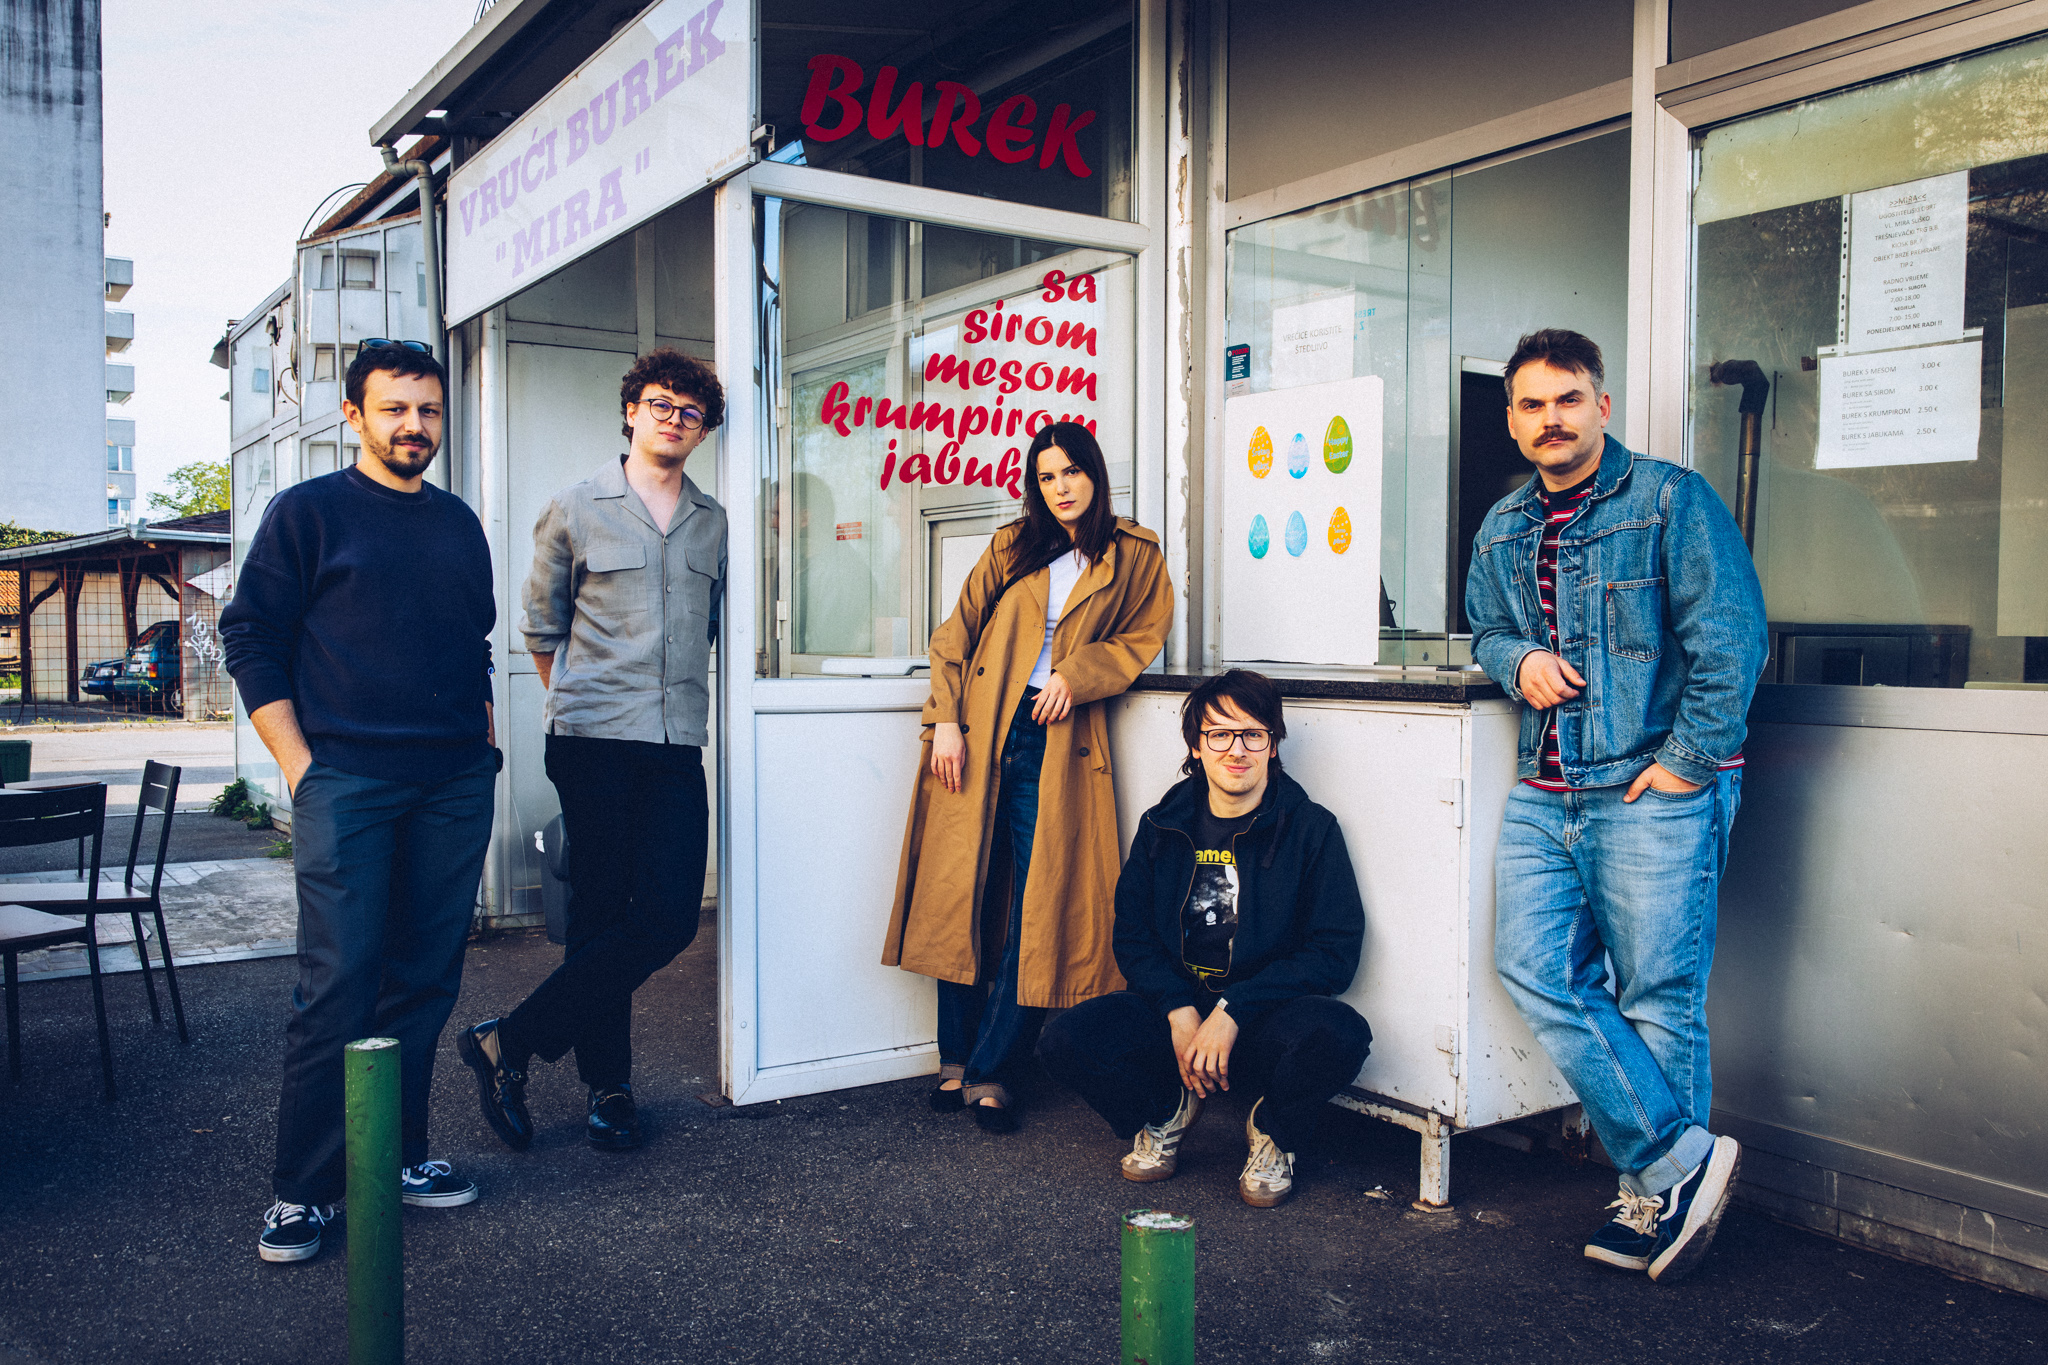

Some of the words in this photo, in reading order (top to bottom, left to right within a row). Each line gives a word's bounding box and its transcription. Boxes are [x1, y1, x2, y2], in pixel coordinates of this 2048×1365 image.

[459, 127, 558, 237] VRUĆI
[567, 0, 726, 167] BUREK
[800, 54, 1097, 178] BUREK
[1894, 219, 1910, 228] MIRA
[1911, 215, 1931, 224] SLIŠKO
[1875, 228, 1915, 241] TREŠNJEVAČKI
[1891, 241, 1908, 249] KIOSK
[1873, 253, 1894, 263] OBJEKT
[1042, 269, 1097, 303] sa
[1882, 277, 1904, 286] RADNO
[1905, 273, 1929, 282] VRIJEME
[1884, 287, 1904, 295] UTORAK
[1908, 283, 1927, 291] SUBOTA
[963, 299, 1097, 357] sirom
[1283, 330, 1308, 342] VREĆICE
[1309, 325, 1342, 338] KORISTITE
[1867, 324, 1912, 335] PONEDJELJKOM
[1922, 320, 1937, 328] RADI
[1295, 341, 1328, 355] ŠTEDLJIVO
[1842, 369, 1864, 378] BUREK
[1870, 366, 1897, 375] MESOM
[1921, 361, 1936, 370] 3.00
[924, 353, 1097, 401] mesom
[1842, 391, 1863, 399] BUREK
[1873, 388, 1896, 397] SIROM
[1918, 384, 1933, 392] 3.00
[1841, 412, 1862, 420] BUREK
[1868, 407, 1911, 418] KRUMPIROM
[1918, 406, 1933, 414] 2.50
[1328, 436, 1349, 446] Happy
[1841, 433, 1862, 441] BUREK
[1867, 429, 1904, 439] JABUKAMA
[1916, 427, 1932, 435] 2.50
[1329, 450, 1349, 460] Easter
[880, 438, 1023, 500] jabuk
